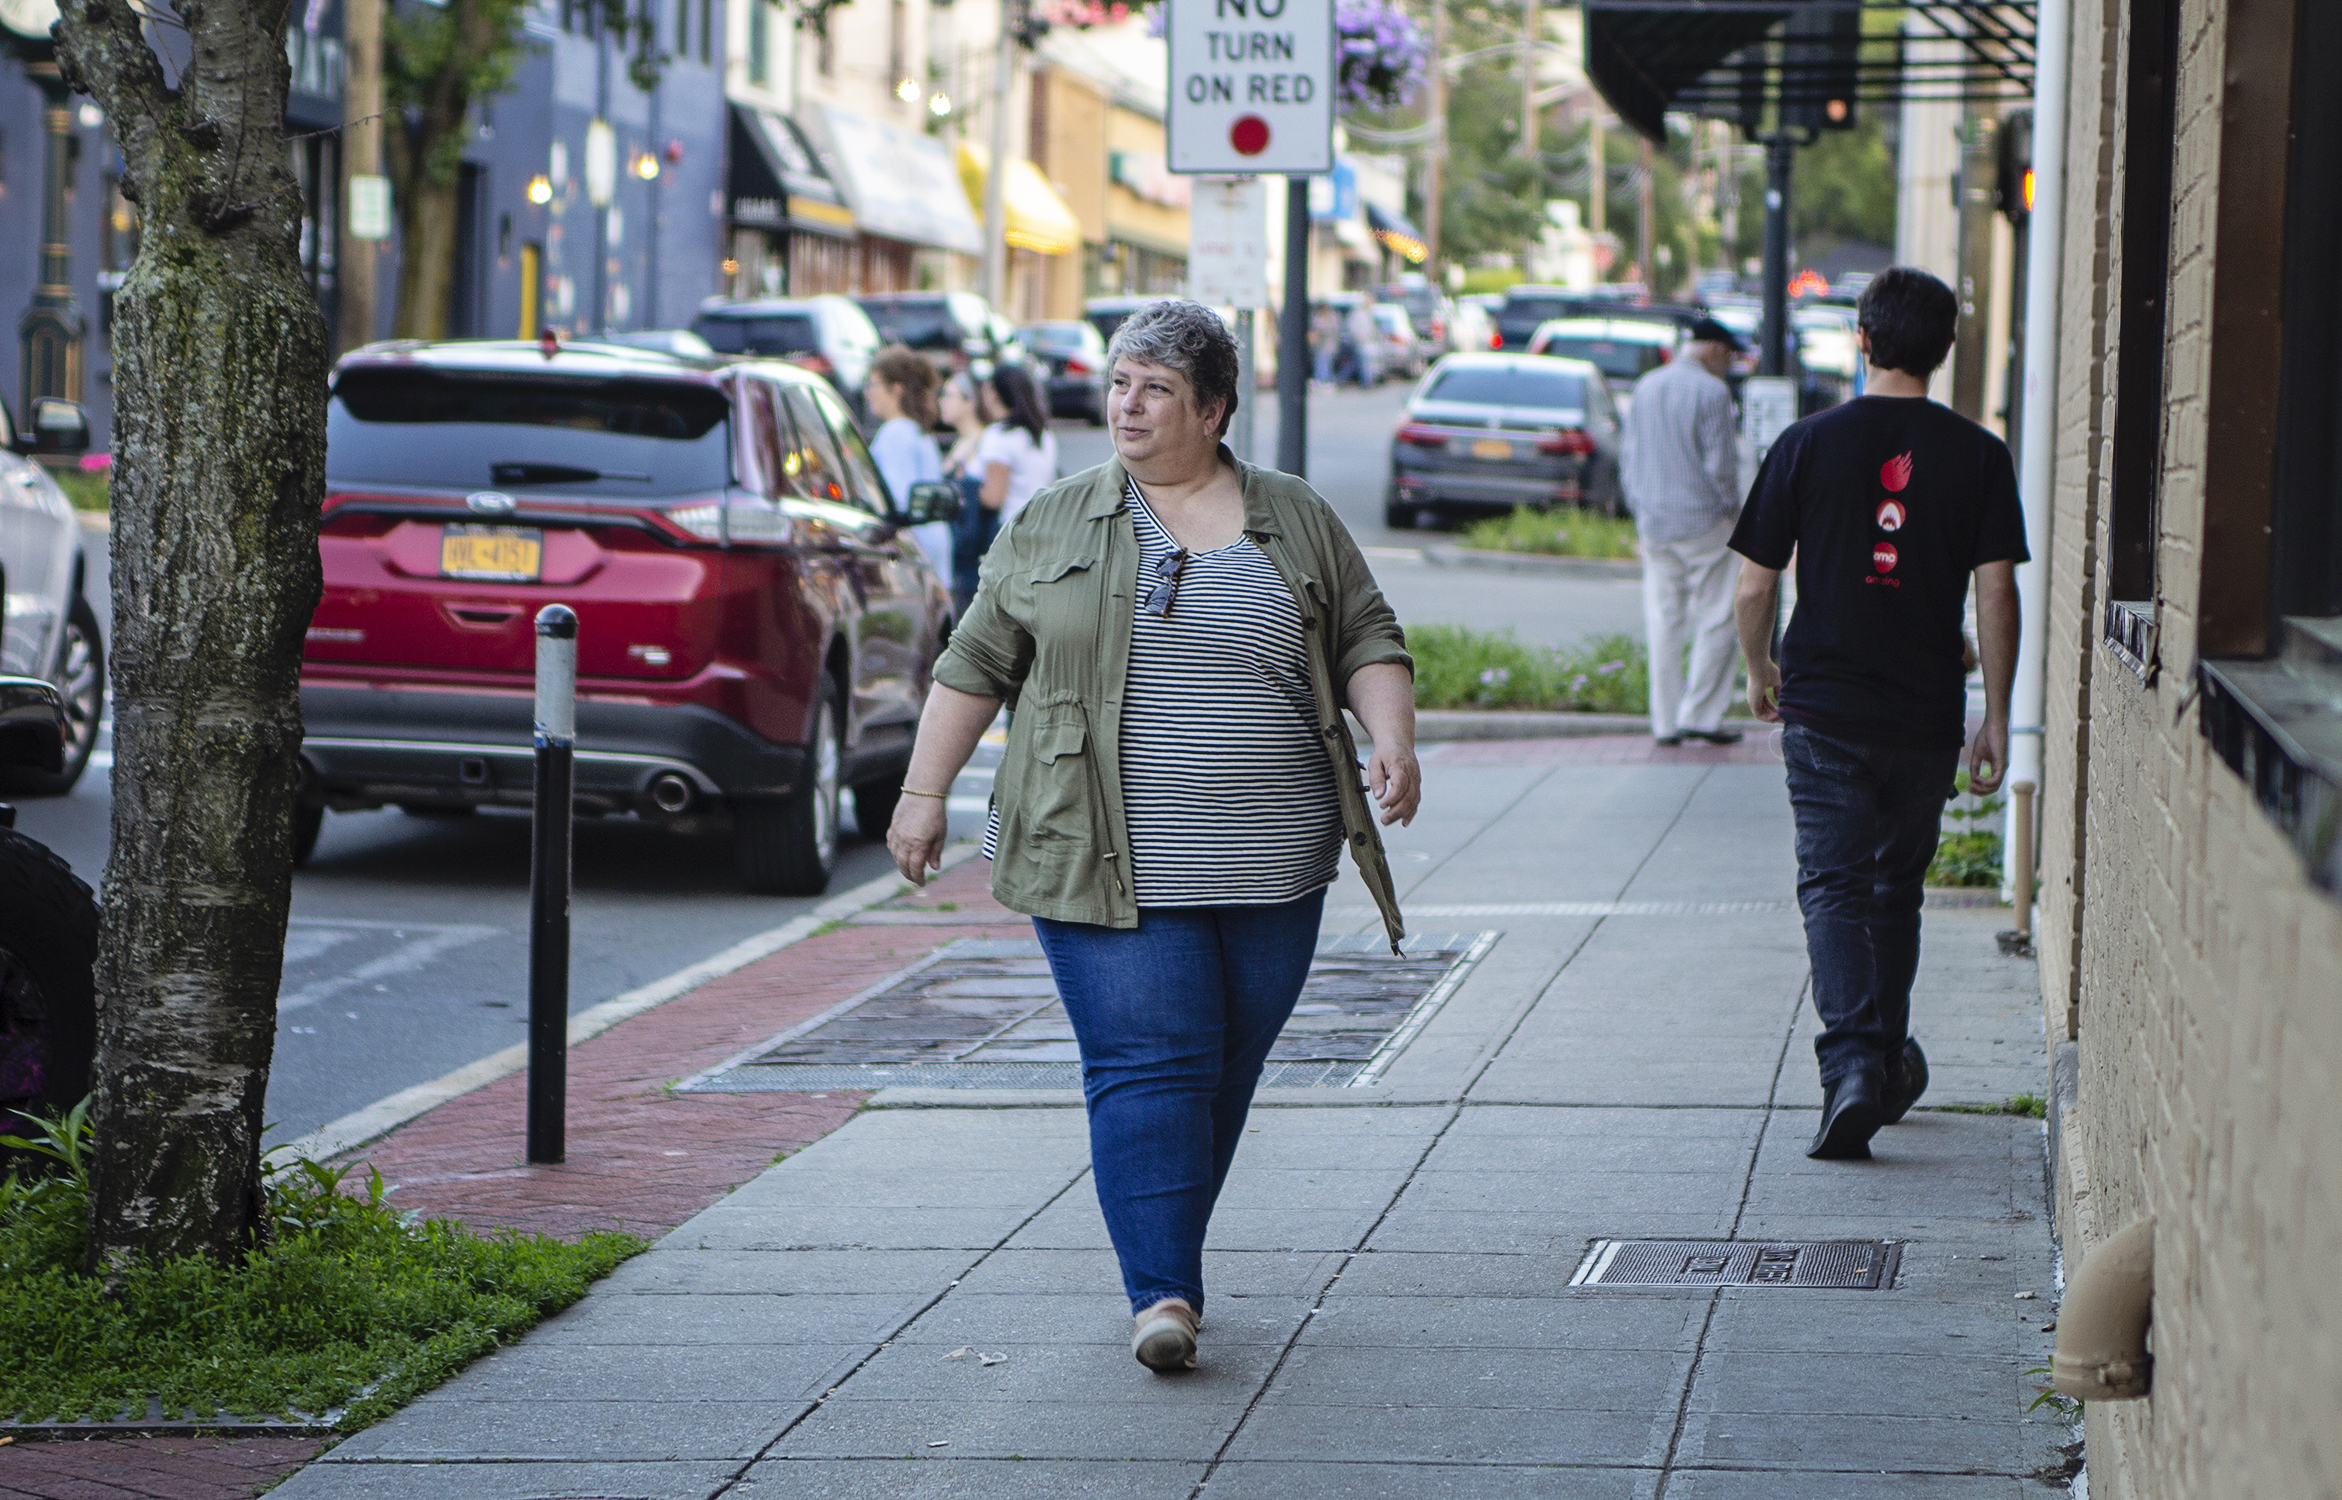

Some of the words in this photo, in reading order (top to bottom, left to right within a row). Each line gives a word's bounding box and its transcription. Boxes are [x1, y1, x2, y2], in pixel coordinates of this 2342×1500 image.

[1206, 31, 1294, 61] TURN
[1186, 73, 1233, 103] ON
[1248, 73, 1315, 103] RED
